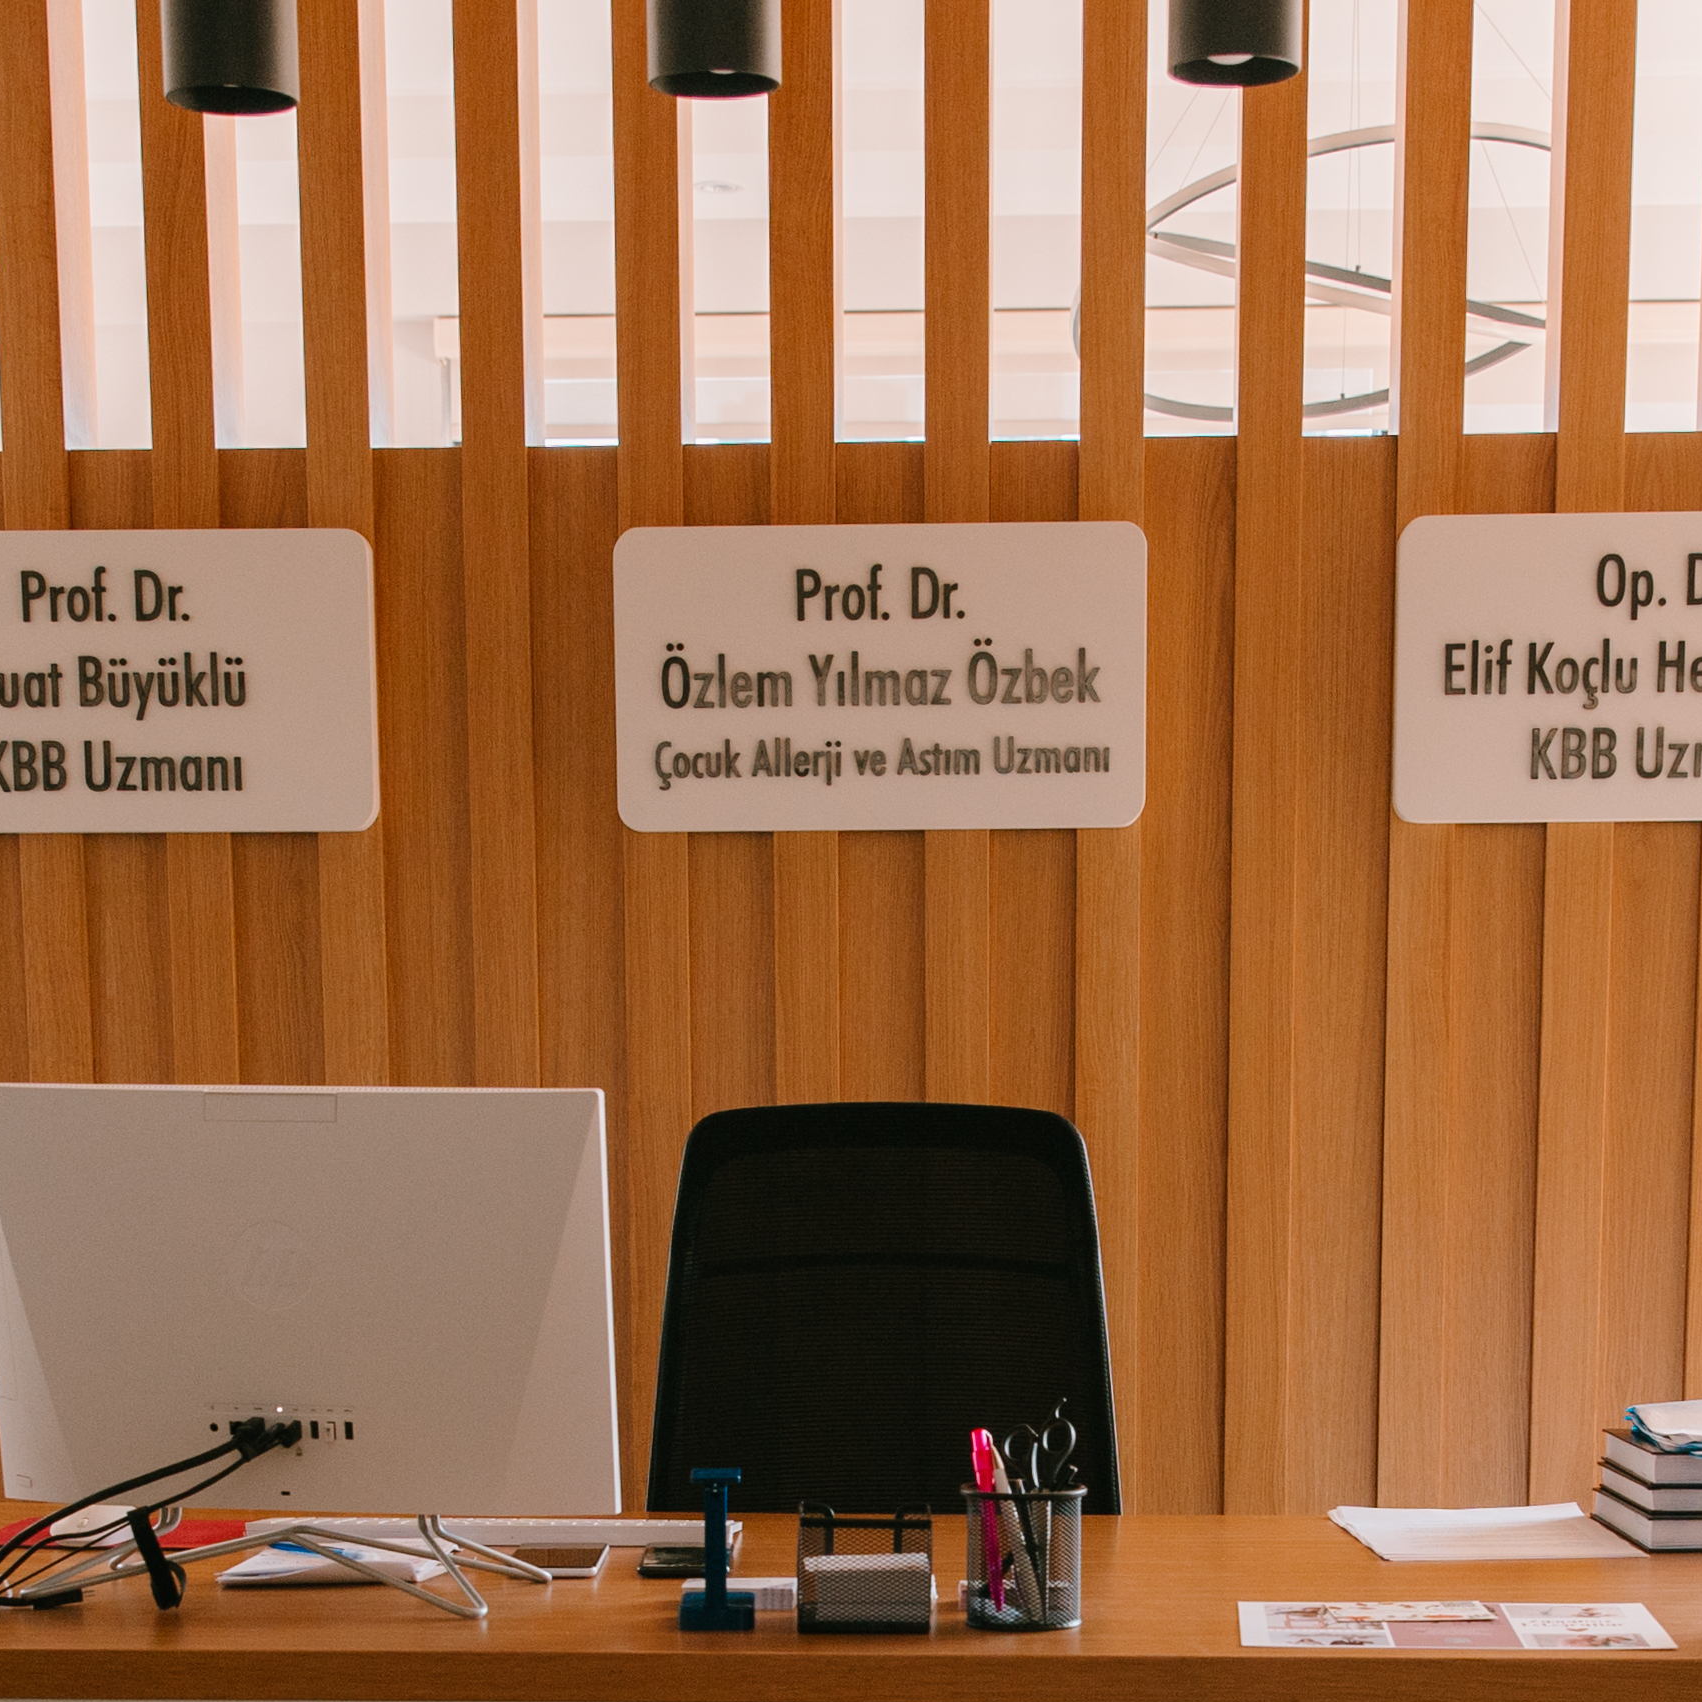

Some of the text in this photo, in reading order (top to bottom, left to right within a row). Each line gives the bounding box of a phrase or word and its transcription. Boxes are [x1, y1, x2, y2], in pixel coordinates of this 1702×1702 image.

[20, 564, 191, 623] Prof. Dr.
[795, 563, 966, 623] Prof. Dr.
[1595, 552, 1667, 622] Op.
[77, 651, 247, 722] Büyüklü
[660, 636, 1101, 710] Özlem Yılmaz Özbek
[1443, 638, 1514, 696] Elif
[1526, 637, 1639, 711] Koçlu
[83, 739, 244, 793] Uzmanı
[653, 735, 1111, 792] Çocuk Allerji ve Astım Uzmanı
[1529, 726, 1618, 781] KBB
